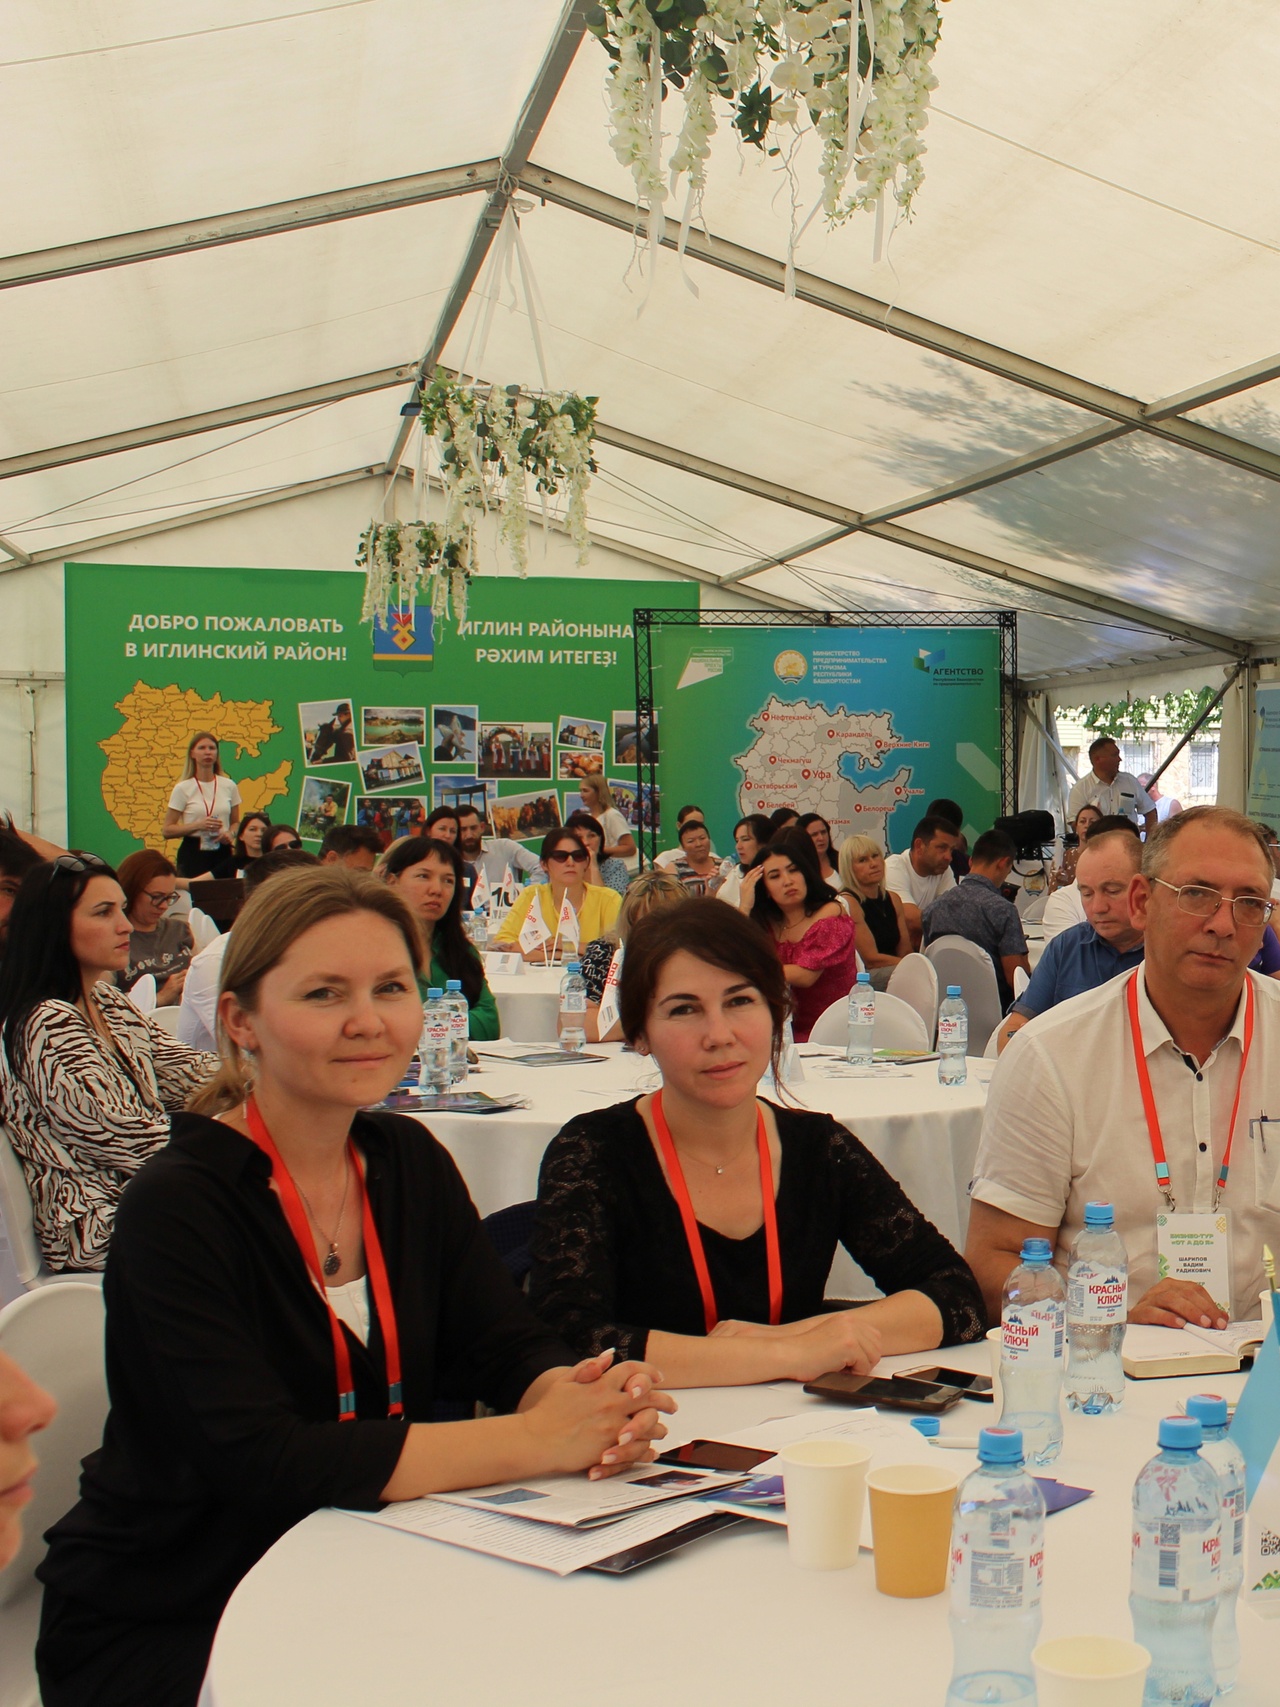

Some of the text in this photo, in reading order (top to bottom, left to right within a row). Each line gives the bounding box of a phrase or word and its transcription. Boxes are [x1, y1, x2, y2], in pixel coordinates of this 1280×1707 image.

[128, 614, 343, 633] ДОБРО ПОЖАЛОВАТЬ
[460, 619, 635, 638] ИГЛИН РАЙОНЫНА
[125, 641, 347, 661] В ИГЛИНСКИЙ РАЙОН!
[475, 649, 544, 664] РӘХИМ
[812, 770, 831, 781] Уфа
[753, 782, 798, 790] Октябрьский
[940, 1020, 958, 1028] РАСНЫЙ
[1097, 1294, 1123, 1305] КЛЮЧ
[1001, 1321, 1039, 1337] РАСНЫЙ
[1003, 1334, 1029, 1347] КЛЮЧ
